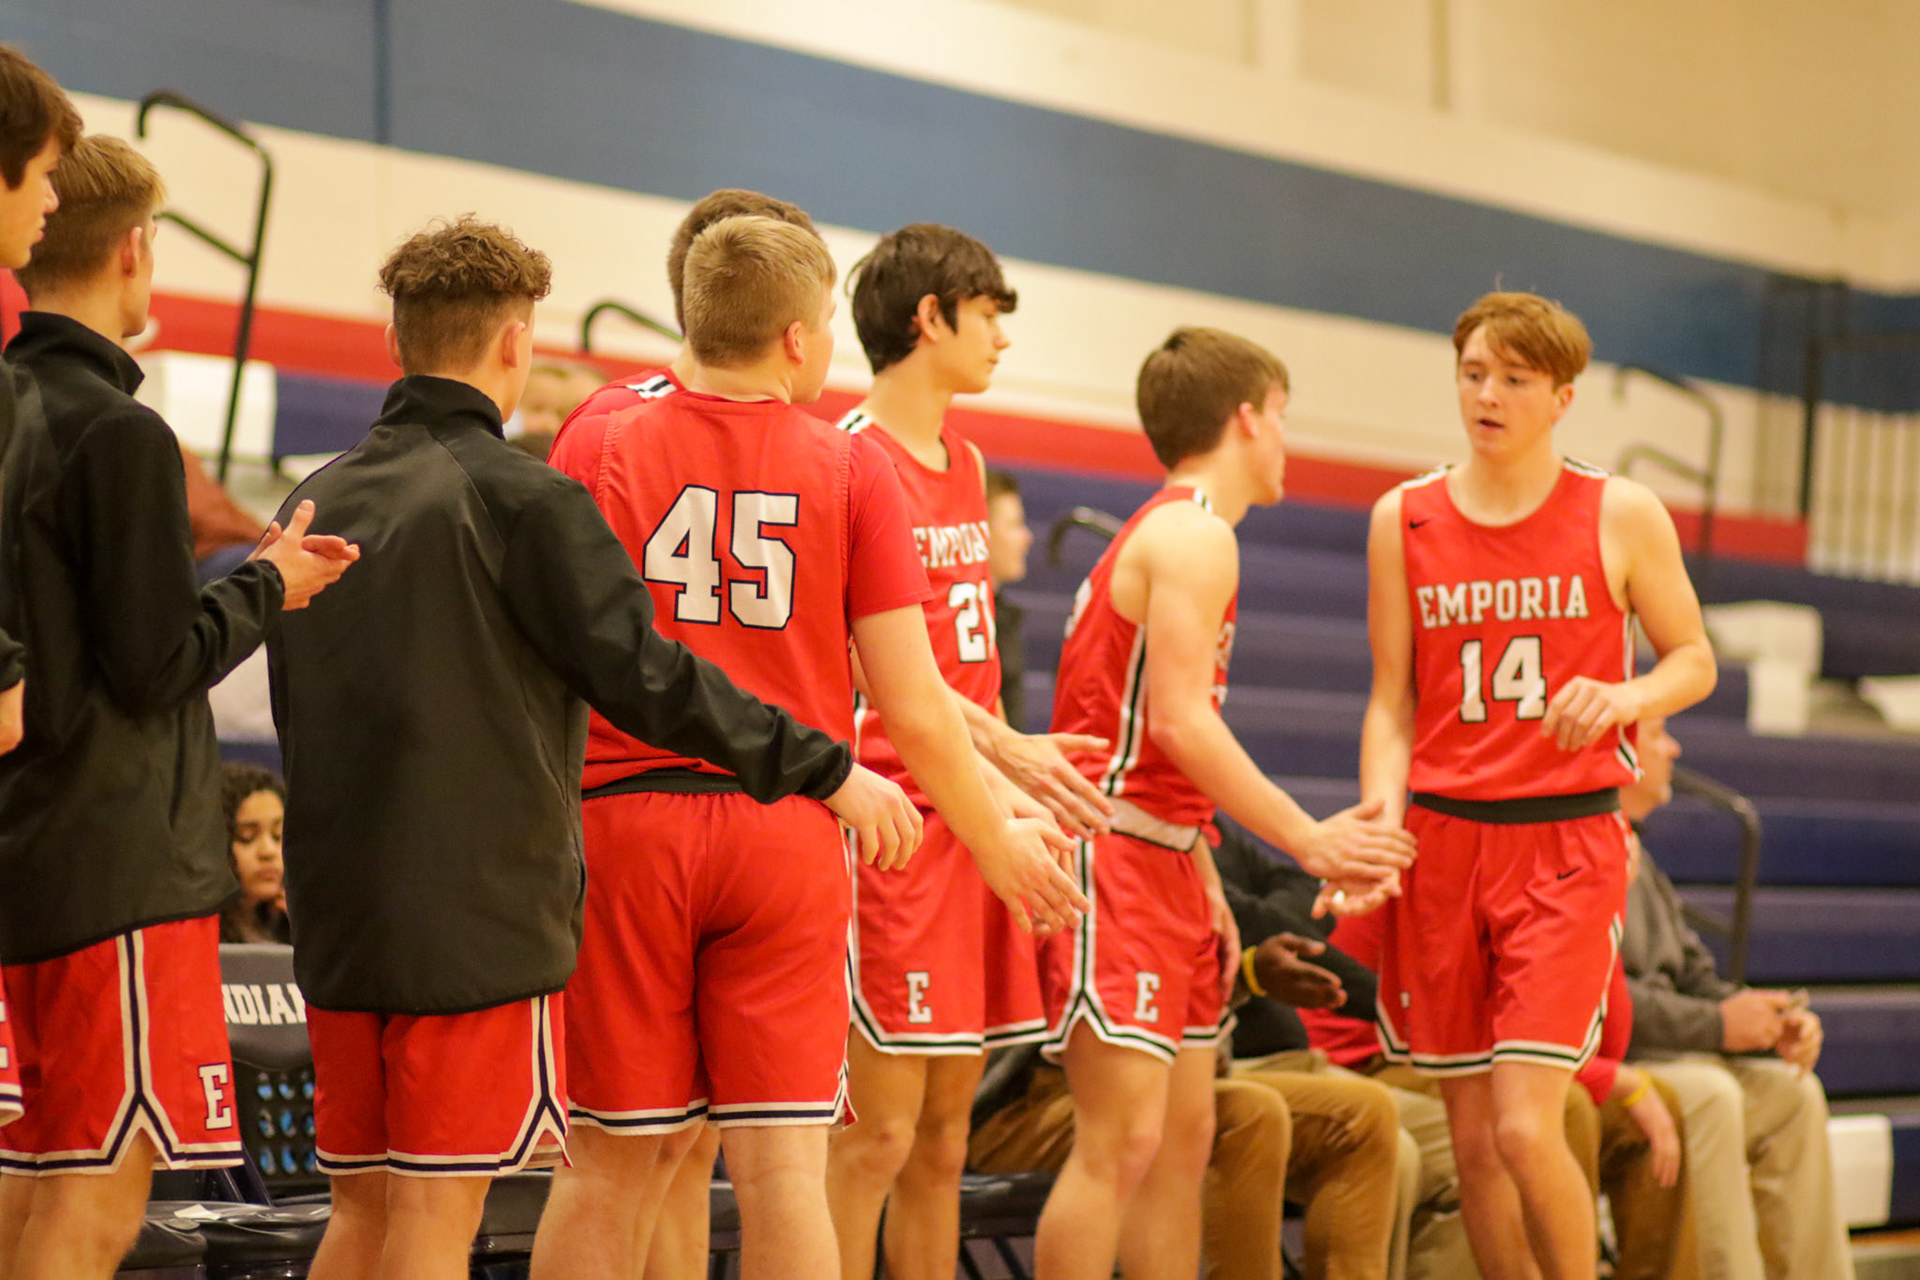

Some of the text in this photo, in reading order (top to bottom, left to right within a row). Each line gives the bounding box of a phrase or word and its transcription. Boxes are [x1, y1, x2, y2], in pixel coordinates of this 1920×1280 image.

[642, 484, 799, 631] 45
[948, 578, 997, 663] 21
[1416, 574, 1589, 629] EMPORIA
[1459, 635, 1547, 723] 14
[906, 972, 932, 1023] E
[1133, 972, 1160, 1023] E
[198, 1063, 232, 1130] E
